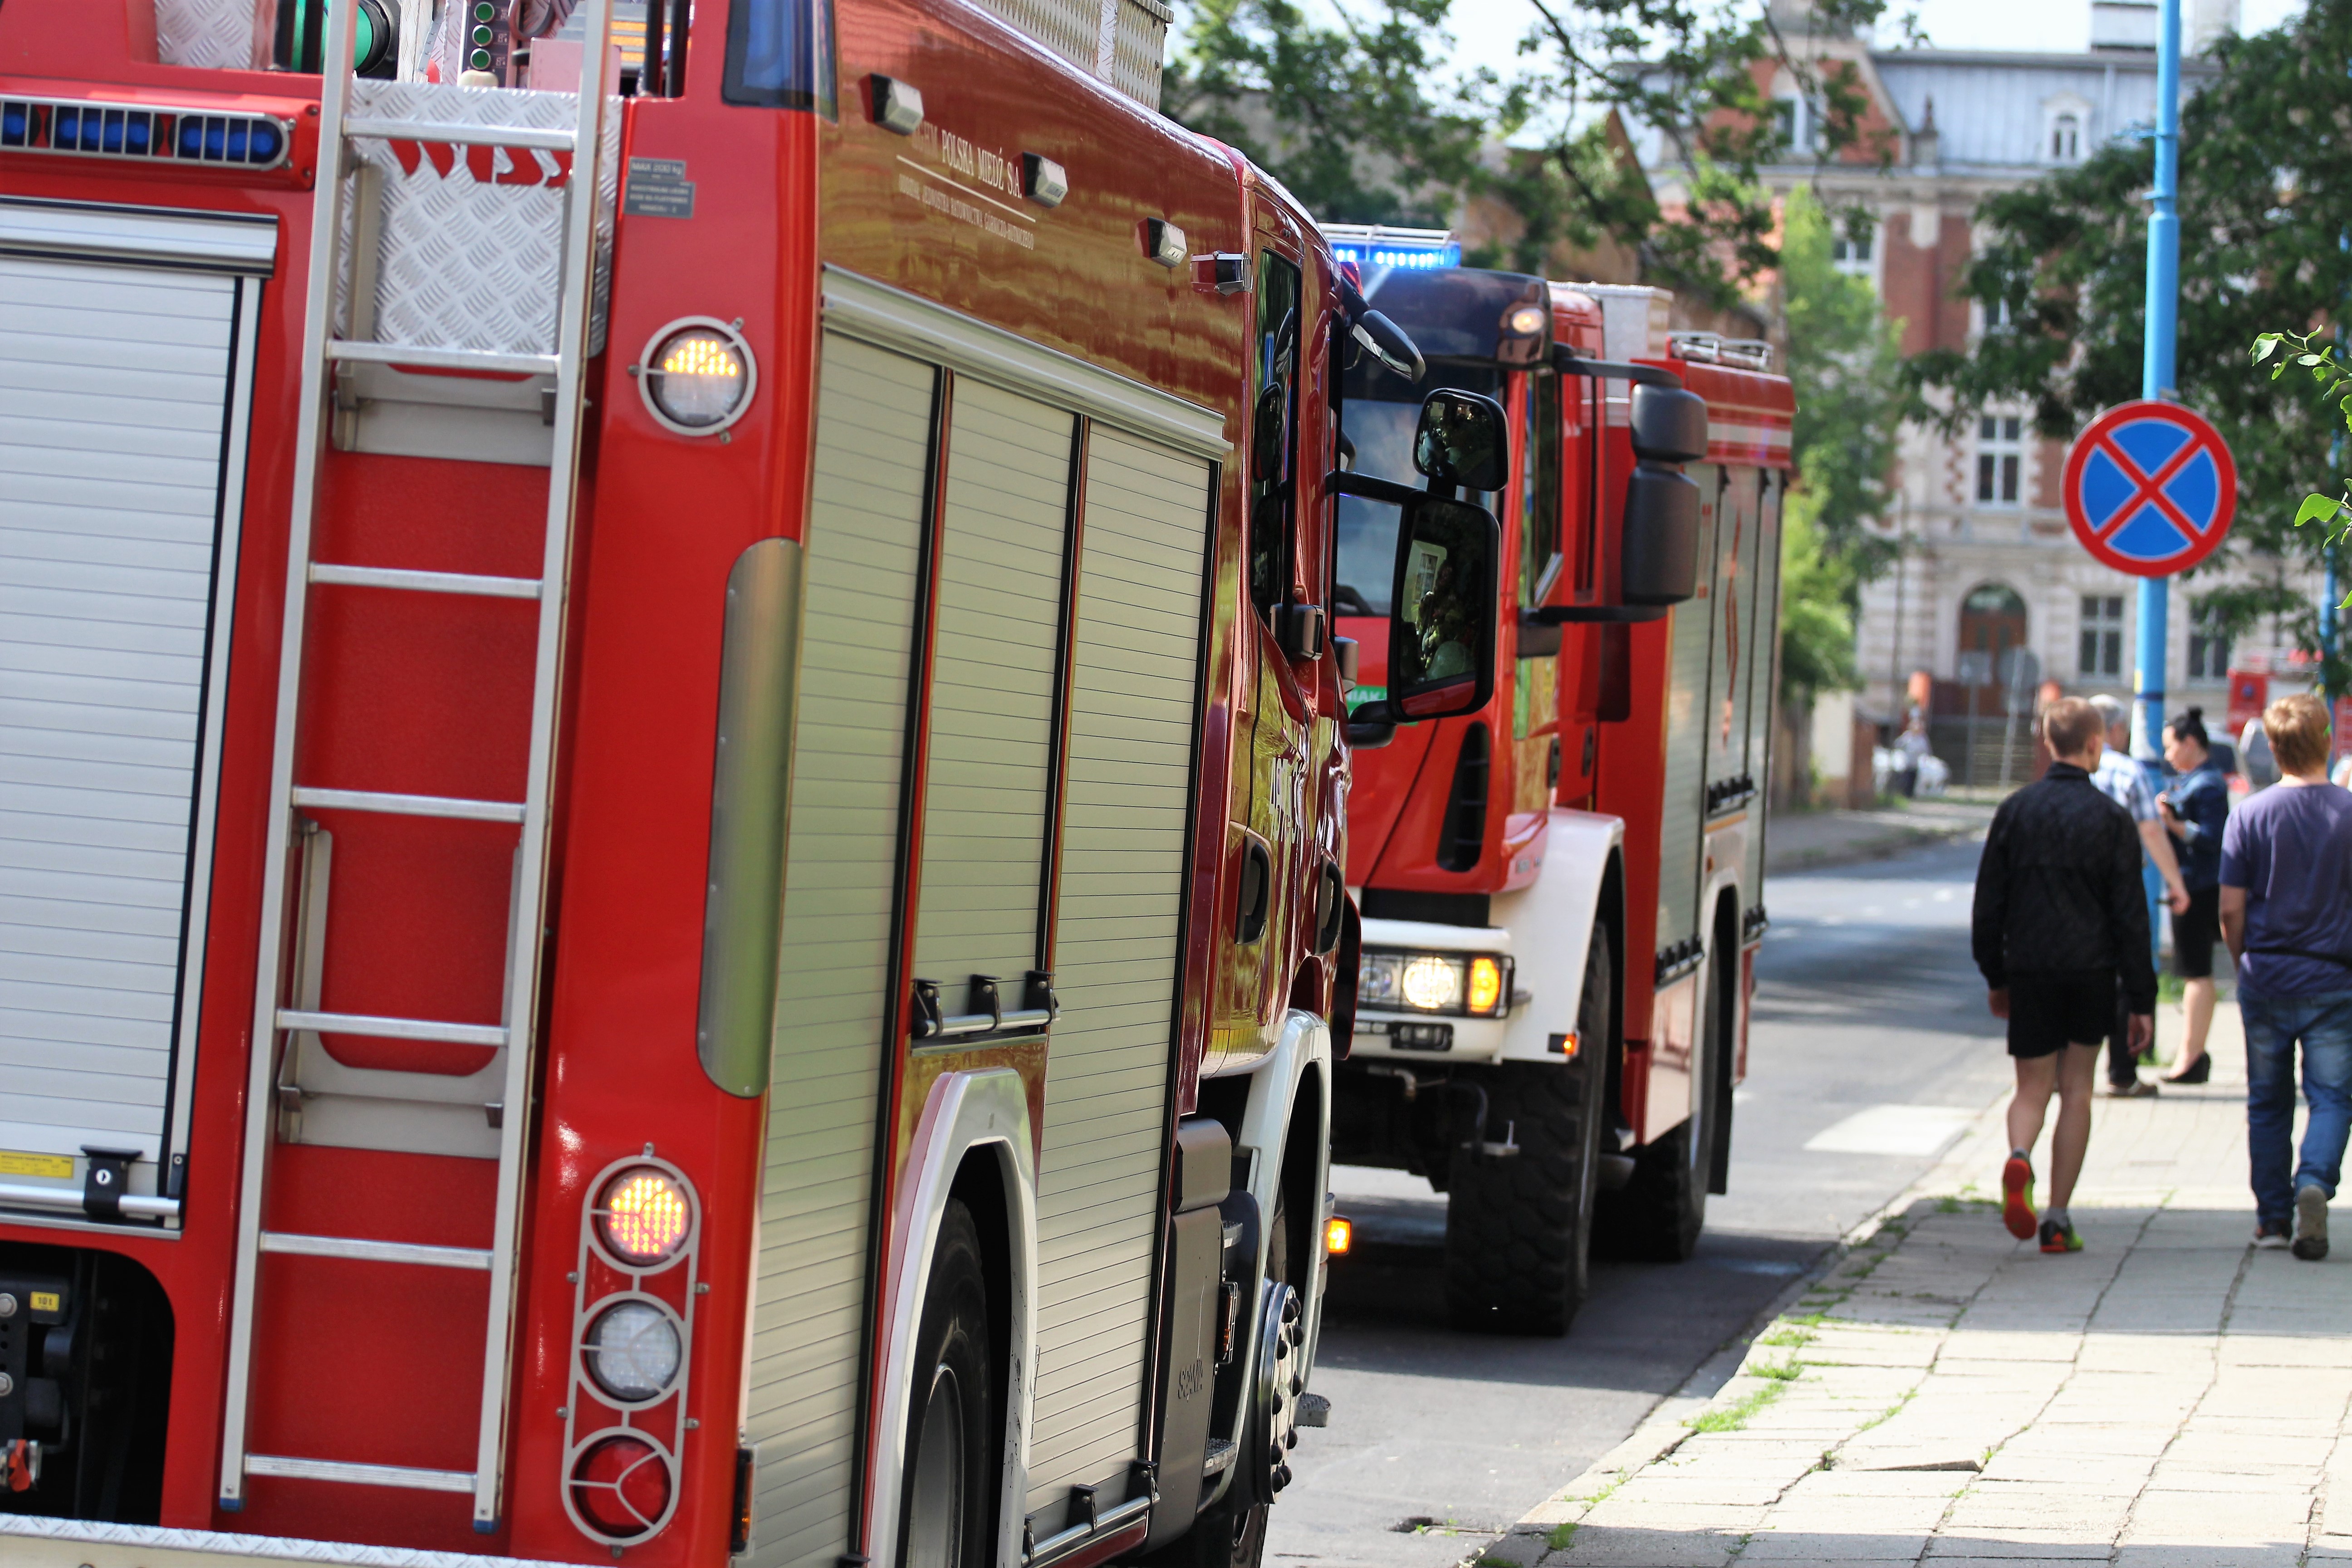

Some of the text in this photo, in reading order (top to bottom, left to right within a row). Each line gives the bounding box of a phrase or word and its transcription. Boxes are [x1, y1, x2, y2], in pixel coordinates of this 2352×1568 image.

[941, 129, 974, 176] POLSKA
[978, 147, 1004, 191] MIEDŹ
[1007, 161, 1022, 199] S.A.
